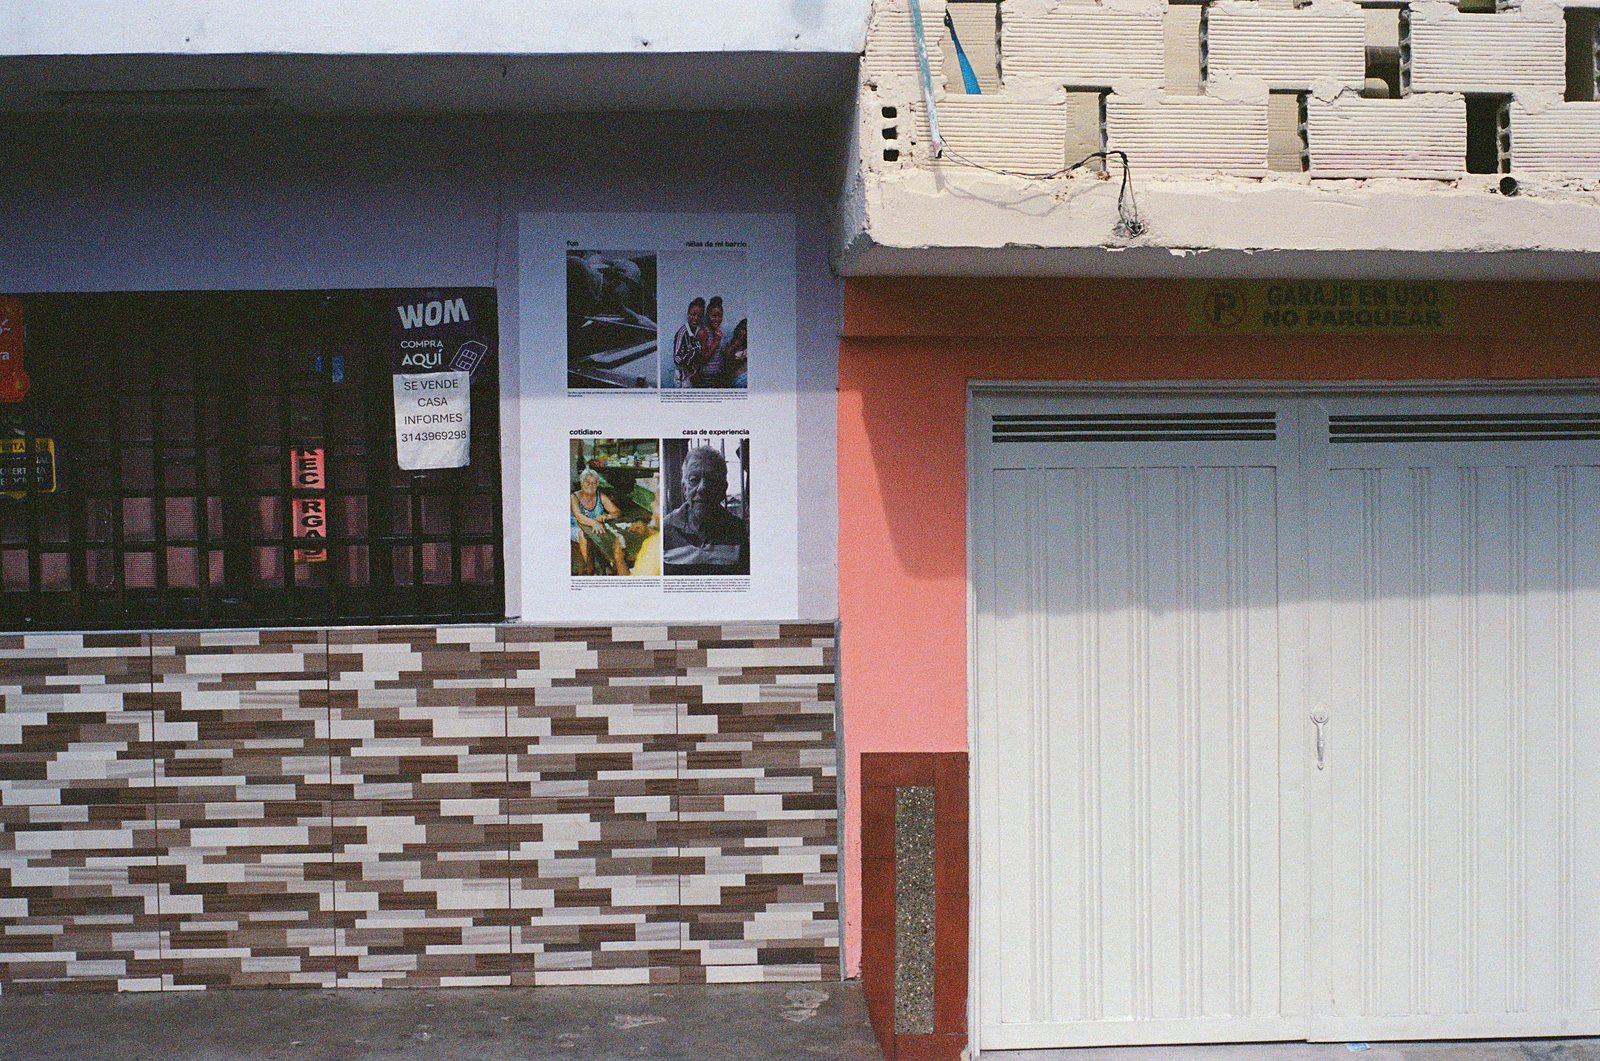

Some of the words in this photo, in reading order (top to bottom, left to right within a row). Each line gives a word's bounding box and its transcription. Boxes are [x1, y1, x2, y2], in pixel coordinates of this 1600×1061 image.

[566, 240, 580, 248] fun
[1267, 284, 1351, 306] GARAJE
[1360, 284, 1388, 305] EN
[1395, 284, 1439, 306] USO
[397, 297, 470, 330] WOM
[1263, 310, 1299, 326] NO
[1307, 310, 1442, 327] PARQUEAR
[400, 339, 444, 349] COMPRA
[401, 348, 443, 369] AQUÍ
[404, 380, 417, 391] SE
[420, 378, 459, 389] VENDE
[417, 397, 448, 408] CASA
[404, 413, 462, 425] INFORMES
[401, 429, 467, 443] 3143969298
[569, 427, 602, 436] cotidiano
[682, 428, 698, 436] casa
[699, 427, 708, 436] de
[709, 427, 749, 438] experiencia
